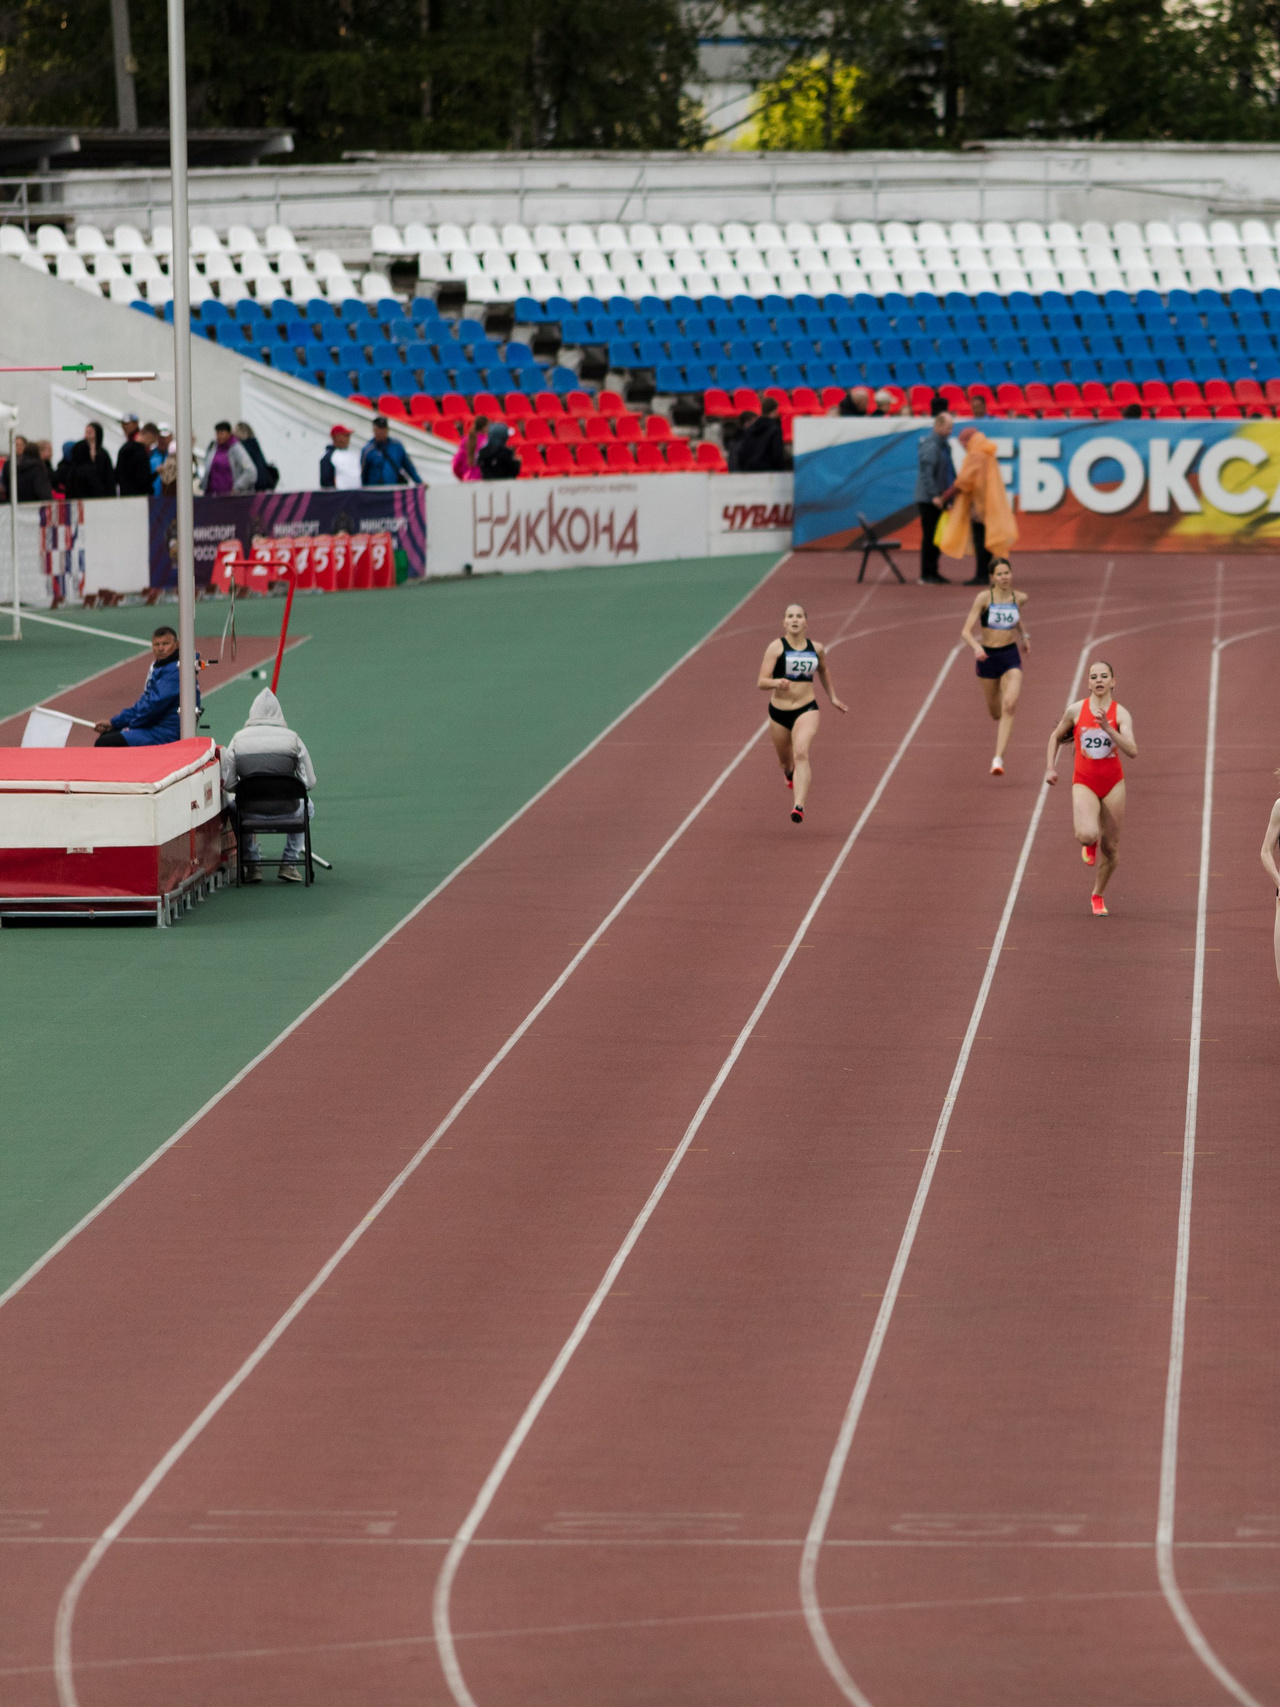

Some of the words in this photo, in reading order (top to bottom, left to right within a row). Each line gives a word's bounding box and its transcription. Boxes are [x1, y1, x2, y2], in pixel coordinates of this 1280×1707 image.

[252, 549, 271, 576] 2
[314, 546, 331, 573] 5
[351, 544, 368, 566] 7
[994, 612, 1014, 623] 316
[792, 660, 813, 672] 257
[1085, 737, 1112, 748] 294
